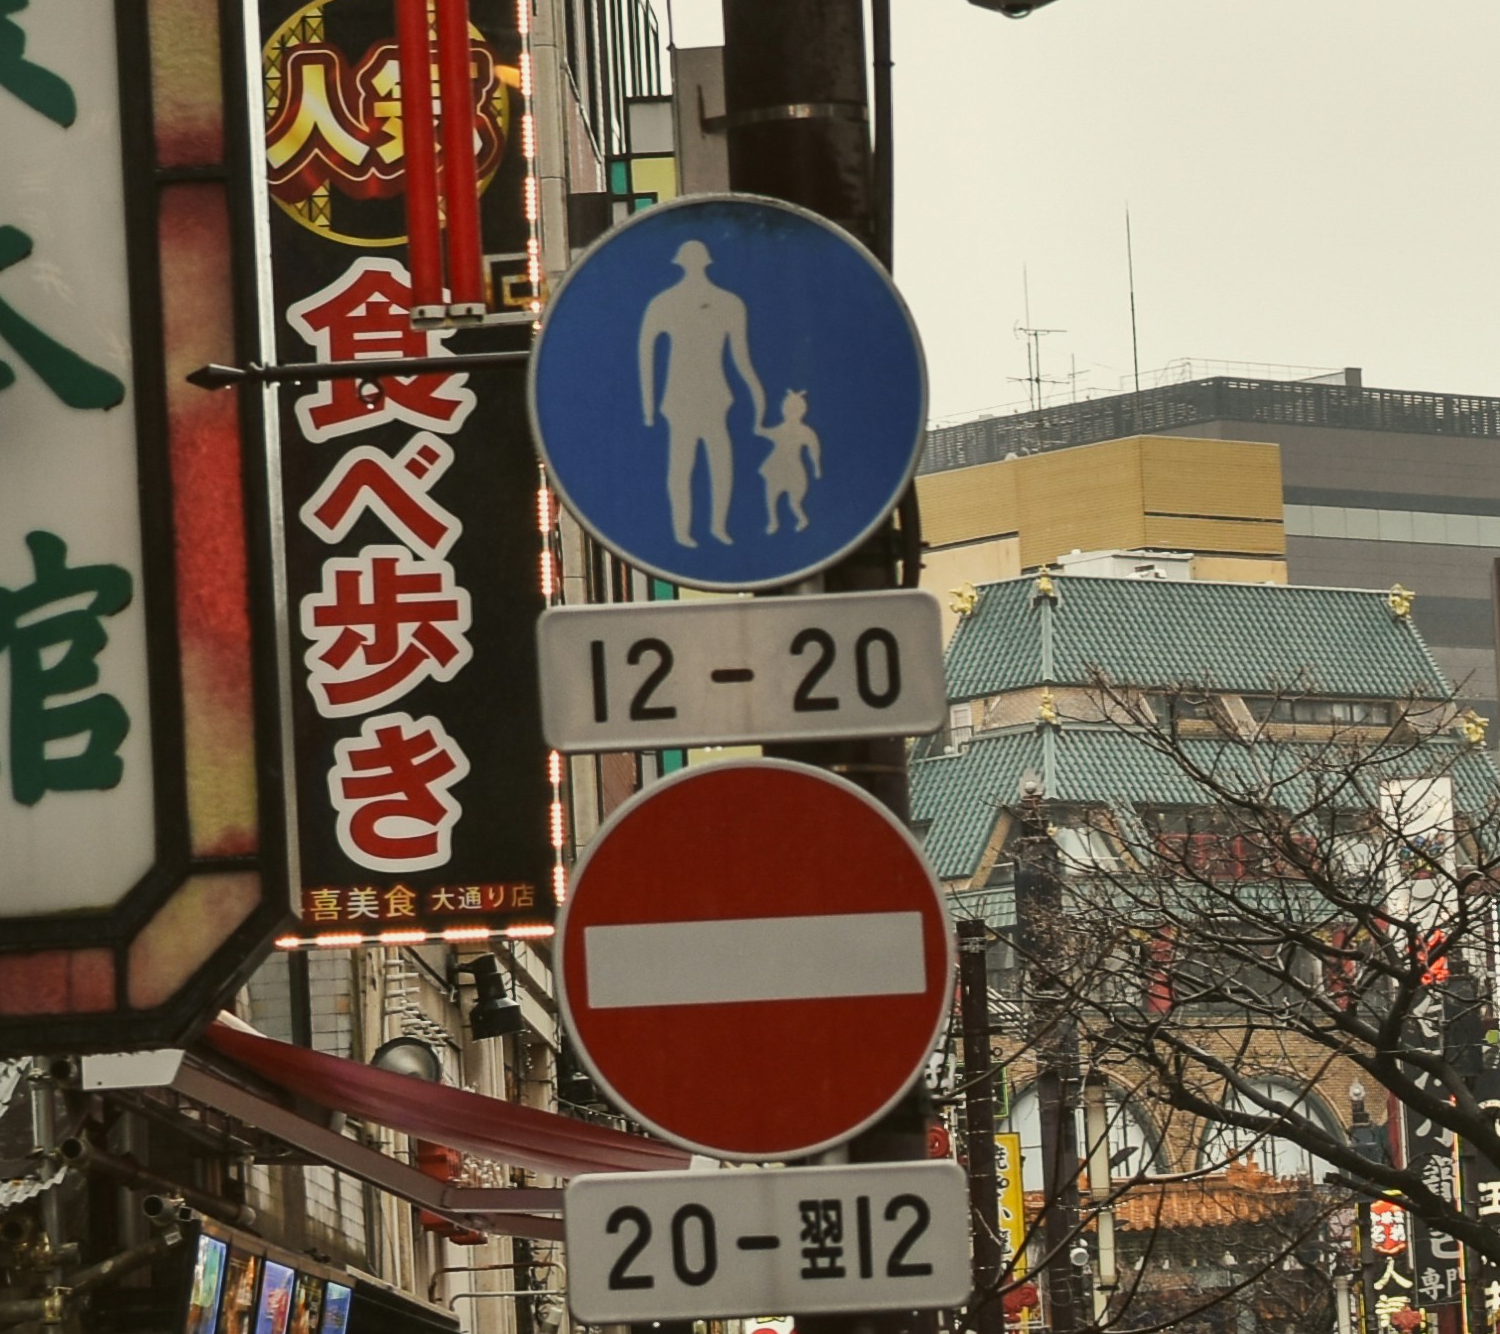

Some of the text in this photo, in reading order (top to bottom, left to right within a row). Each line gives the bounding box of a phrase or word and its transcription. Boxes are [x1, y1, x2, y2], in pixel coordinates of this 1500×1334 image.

[294, 263, 470, 869] 食べ歩き
[299, 883, 536, 921] 喜美食 大通り店
